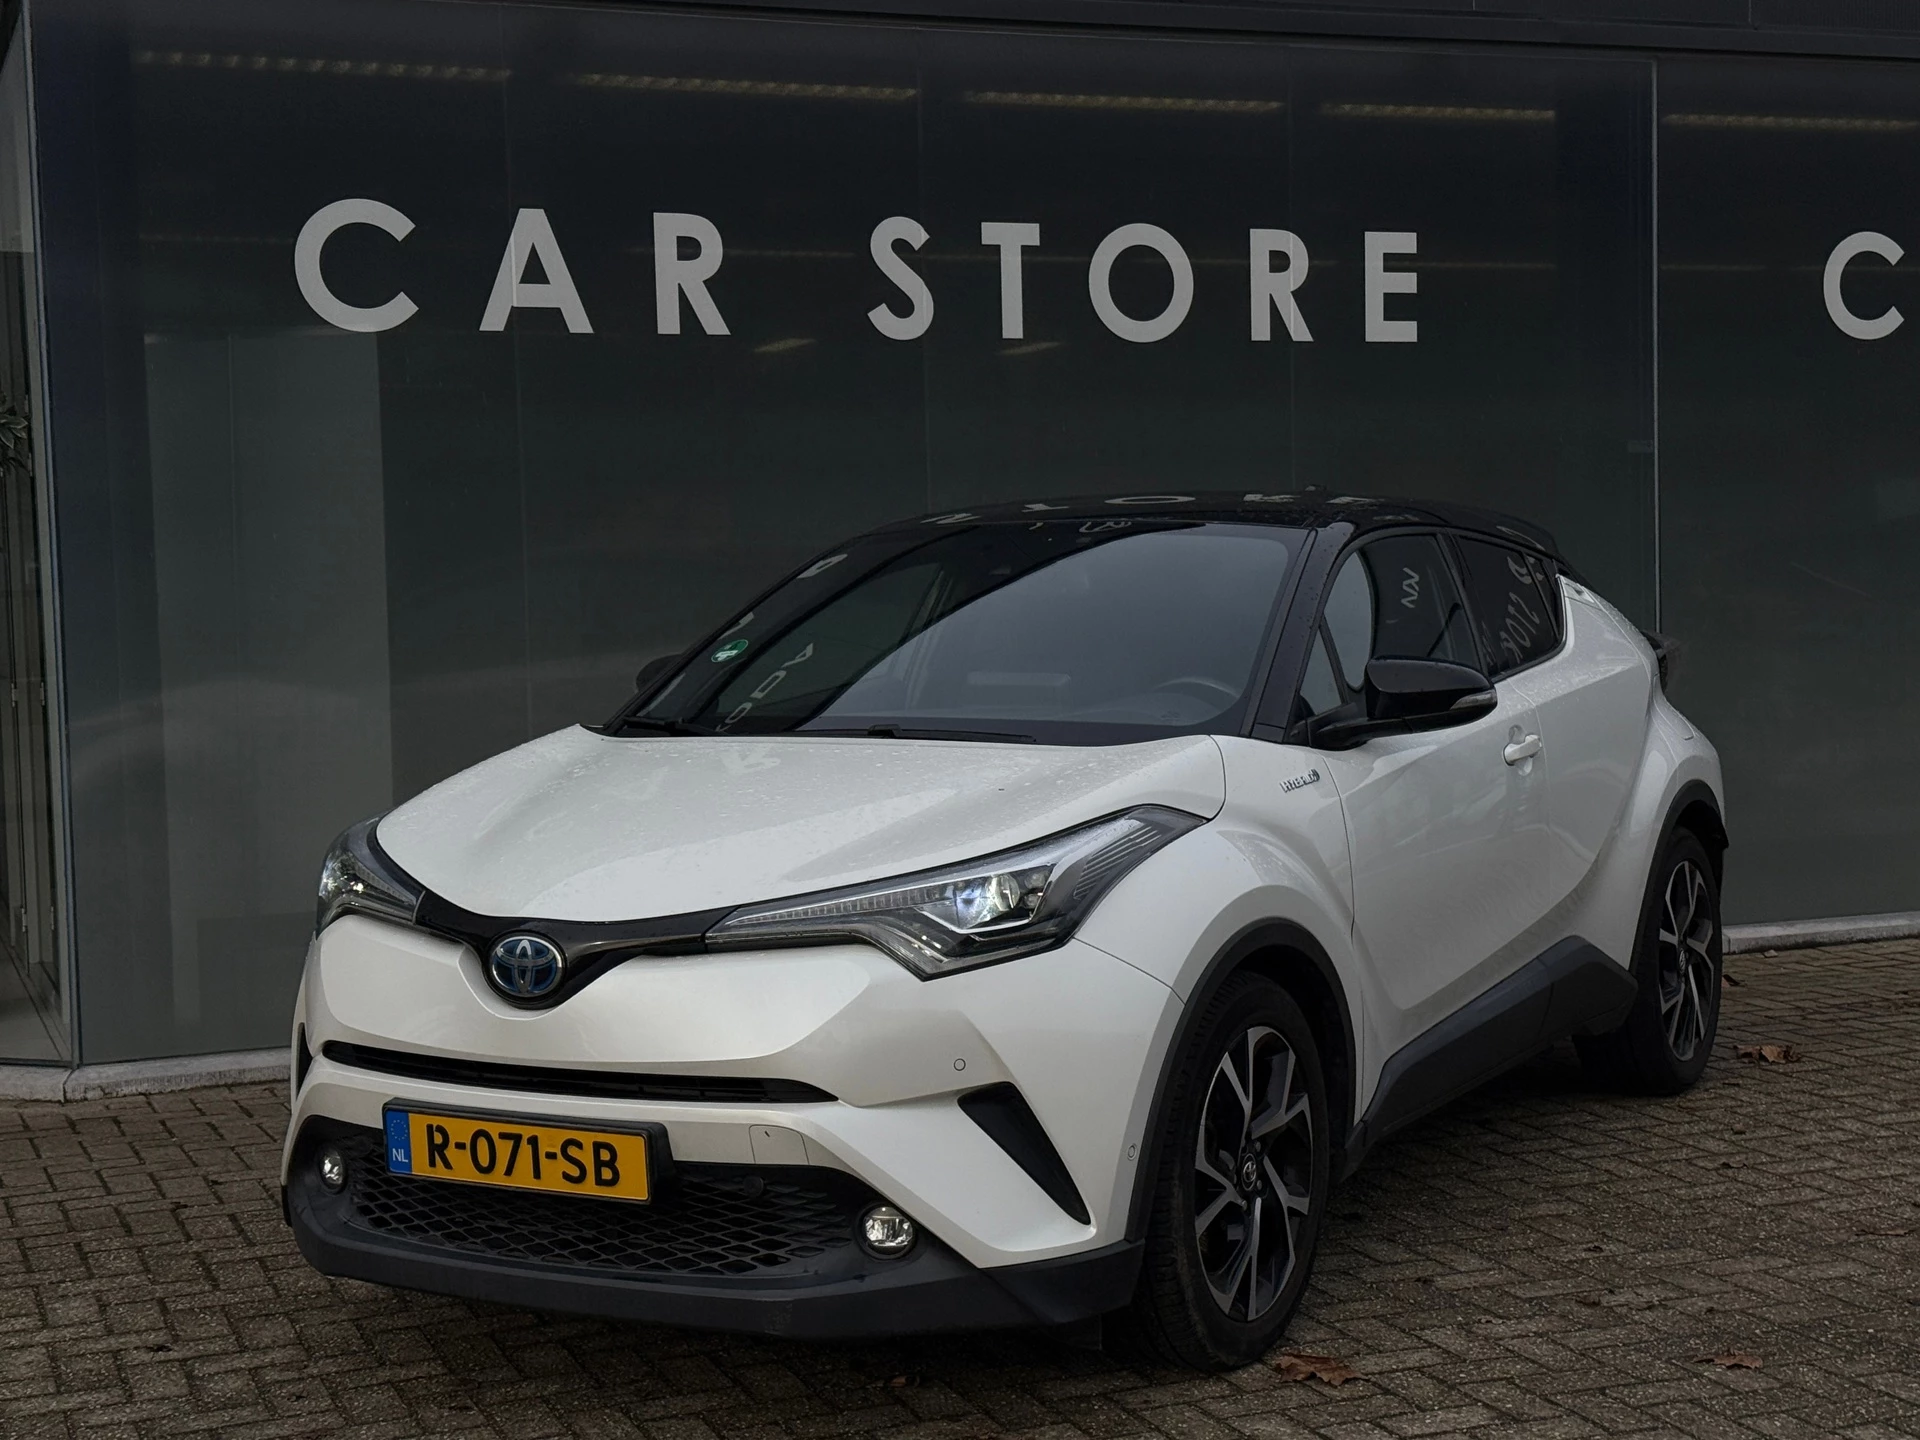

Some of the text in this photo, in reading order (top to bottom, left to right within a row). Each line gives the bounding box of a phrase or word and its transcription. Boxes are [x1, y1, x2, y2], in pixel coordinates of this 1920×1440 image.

[294, 198, 1418, 343] CAR STORE
[1823, 231, 1905, 341] C
[392, 1148, 409, 1163] NL
[425, 1123, 620, 1187] R-071-SB
